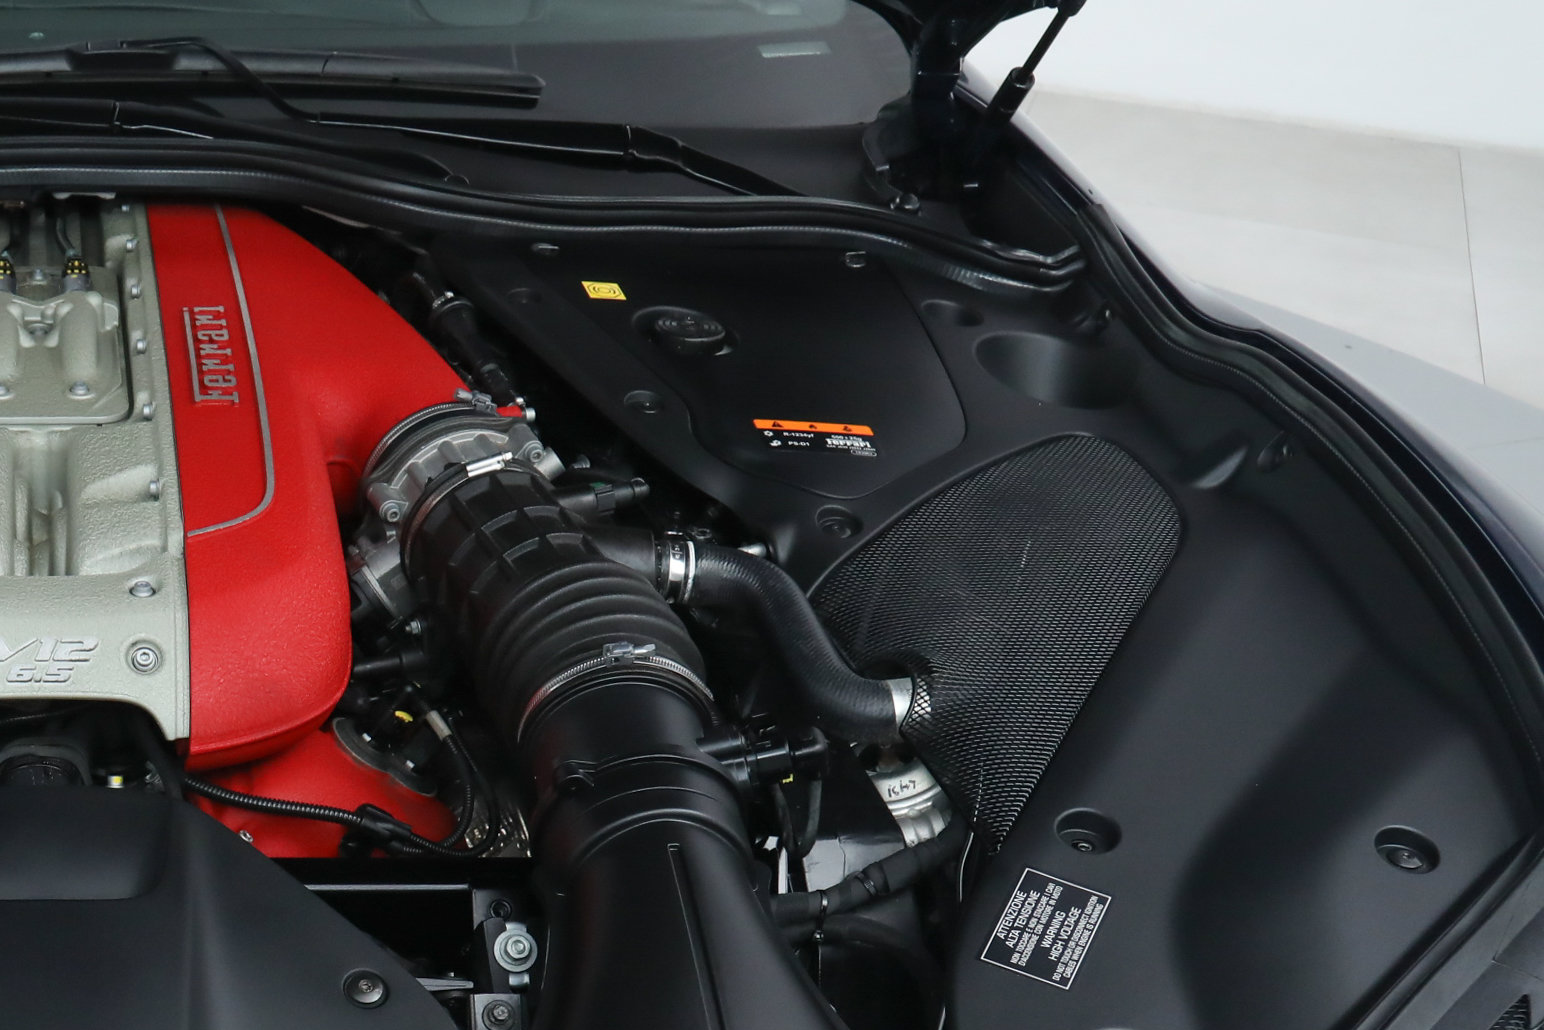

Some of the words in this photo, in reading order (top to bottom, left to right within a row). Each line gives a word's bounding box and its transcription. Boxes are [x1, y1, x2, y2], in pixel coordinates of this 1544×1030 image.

[183, 306, 239, 403] Ferrari
[6, 664, 74, 683] 6.5
[1050, 885, 1063, 899] MOTO
[995, 890, 1027, 939] ATTENZIONE
[1032, 895, 1049, 918] STACCARE
[1038, 904, 1053, 924] MOTORE
[1083, 894, 1098, 915] IGNITION
[1004, 928, 1021, 948] ALTA
[1013, 889, 1040, 929] TENSIONE
[1027, 916, 1038, 928] NON
[1033, 923, 1044, 934] CON
[1040, 909, 1066, 948] WARNING
[1070, 913, 1089, 941] DISCONNECT
[1015, 931, 1031, 952] TOCCARE
[1047, 939, 1065, 961] HIGH
[1057, 906, 1081, 940] VOLTAGE
[1062, 959, 1076, 978] CABLES
[1070, 945, 1083, 960] WHEN
[1077, 929, 1091, 946] ENGINE
[1088, 902, 1103, 924] RUNNING
[1067, 940, 1076, 948] OR
[1009, 952, 1021, 963] NON
[1060, 947, 1073, 963] TOUCH
[1051, 972, 1061, 980] DO
[1055, 962, 1066, 973] NOT
